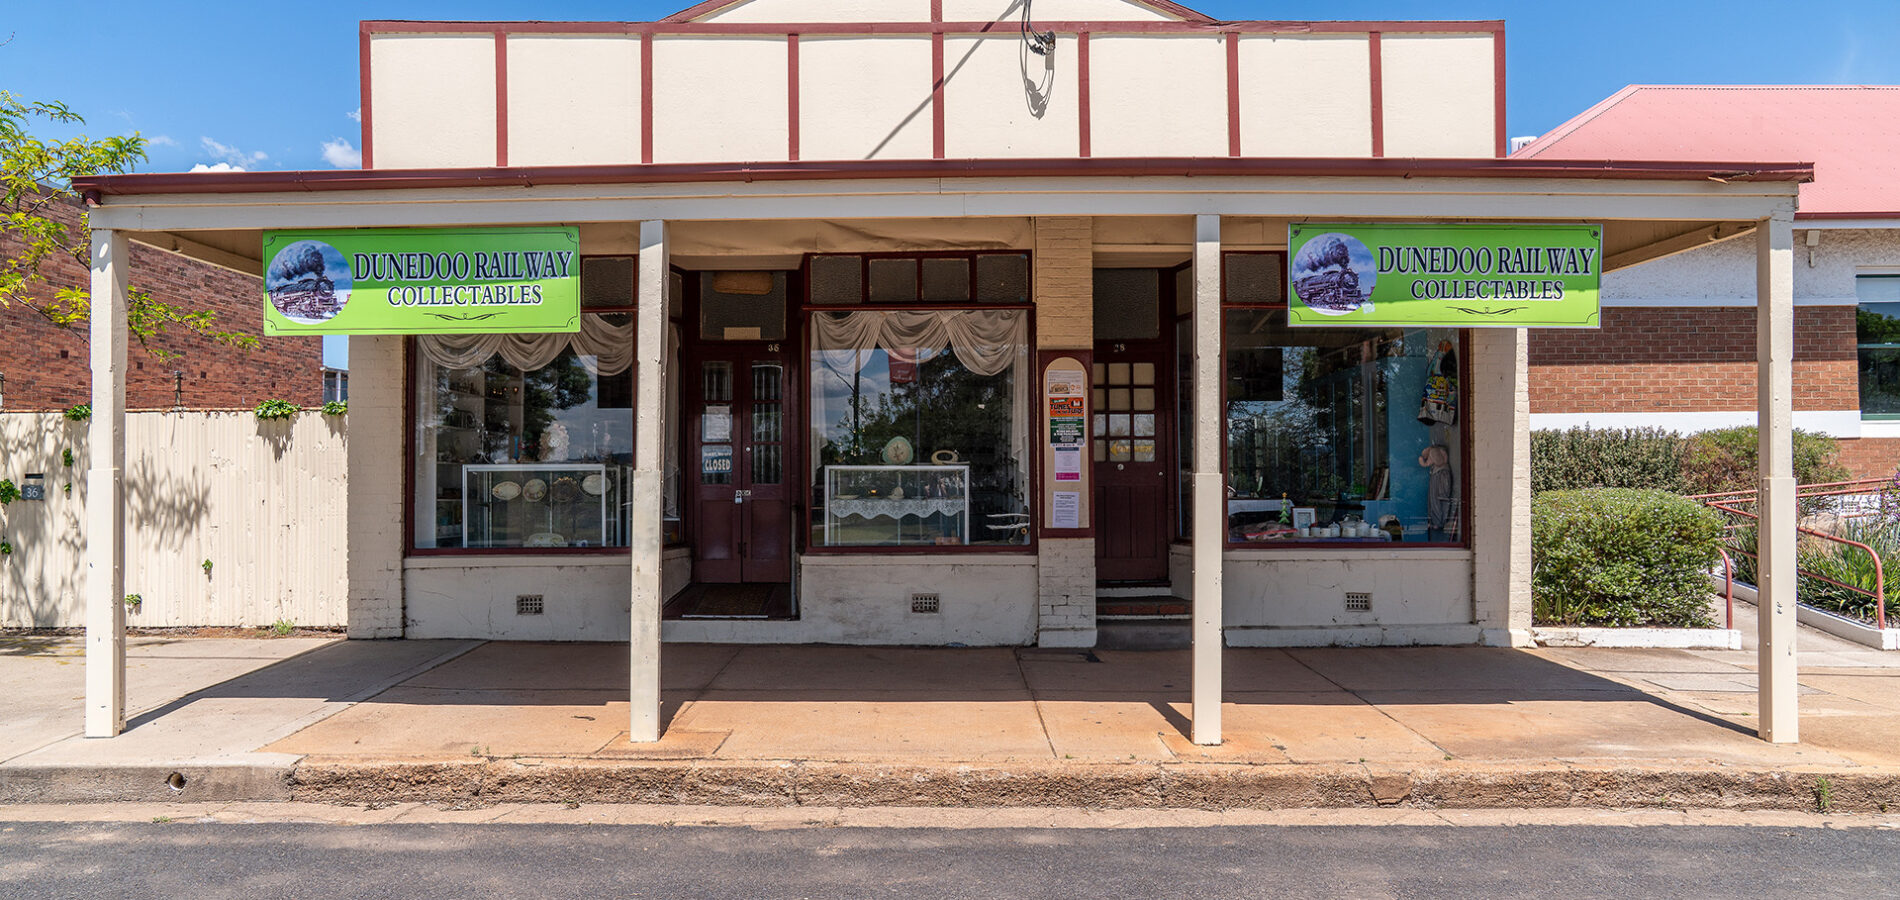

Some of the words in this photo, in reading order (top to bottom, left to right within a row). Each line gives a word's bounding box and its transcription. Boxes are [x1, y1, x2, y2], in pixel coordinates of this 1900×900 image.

[354, 252, 470, 281] DUNEDOO
[474, 250, 572, 279] RAILWAY
[1378, 246, 1493, 275] DUNEDOO
[1497, 246, 1596, 275] RAILWAY
[387, 284, 543, 307] COLLECTABLES
[1410, 279, 1565, 301] COLLECTABLES
[704, 458, 731, 471] CLOSED
[26, 487, 39, 498] 36
